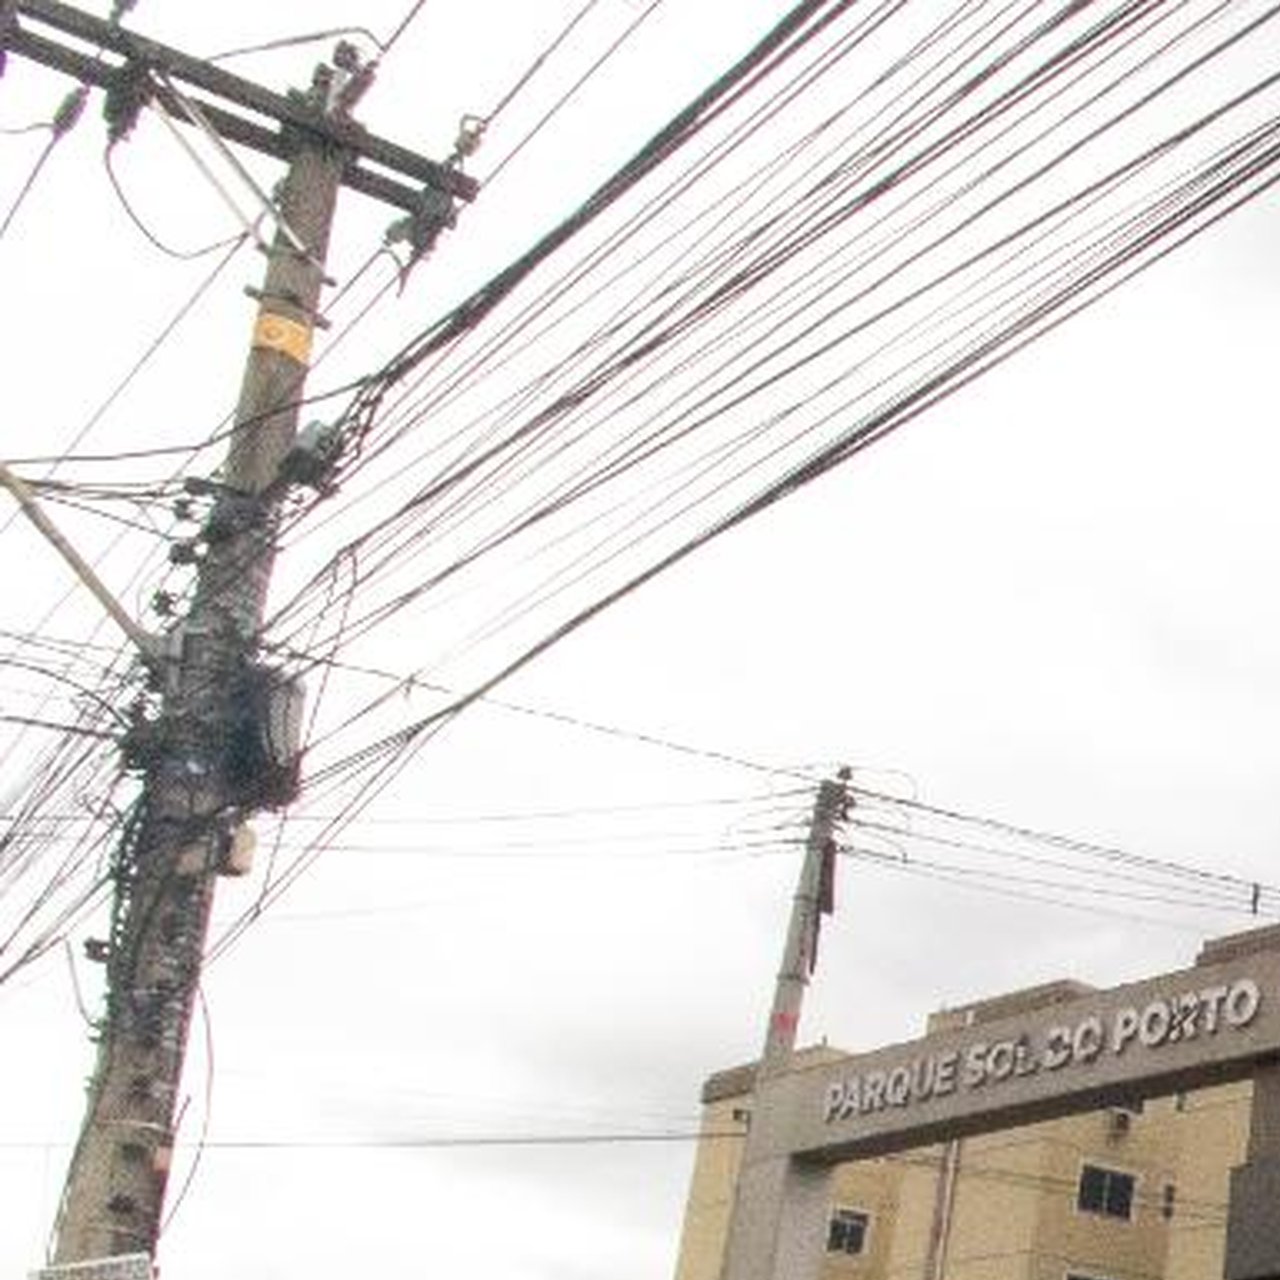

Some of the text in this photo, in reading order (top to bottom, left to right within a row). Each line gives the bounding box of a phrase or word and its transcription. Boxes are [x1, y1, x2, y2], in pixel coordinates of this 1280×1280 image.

[825, 1053, 959, 1122] PARQUE
[965, 1041, 1038, 1088] SOL
[1113, 978, 1261, 1054] PORTO
